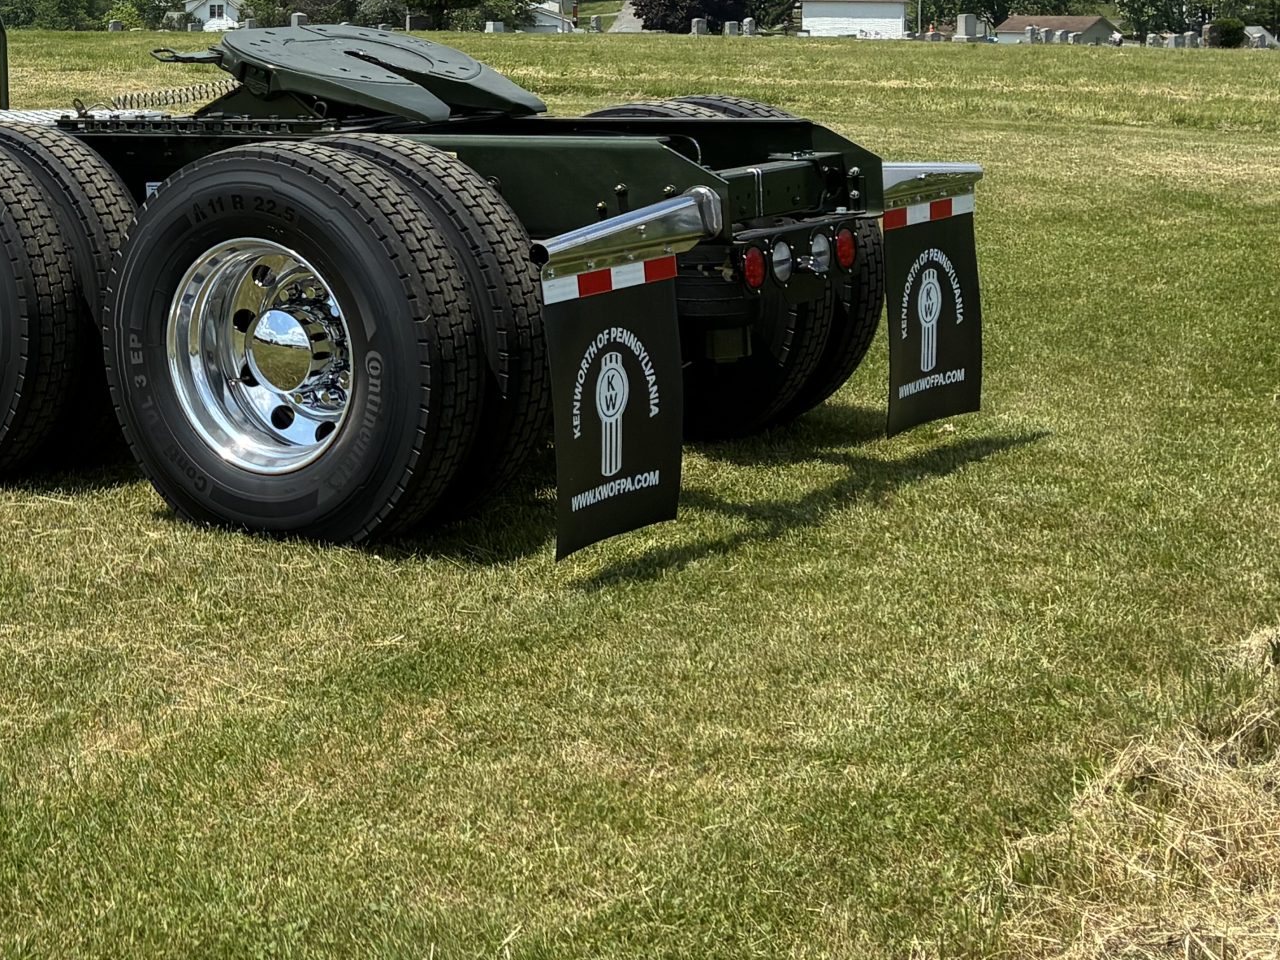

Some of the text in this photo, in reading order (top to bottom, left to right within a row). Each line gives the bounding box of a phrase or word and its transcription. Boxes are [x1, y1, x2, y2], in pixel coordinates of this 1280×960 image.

[208, 193, 297, 223] 11 R 22.5
[901, 248, 963, 339] KENWORTH OF PENNSYLVANIA
[926, 287, 933, 302] K
[924, 302, 934, 317] W
[128, 333, 144, 365] EP
[133, 374, 147, 389] 3
[573, 326, 660, 439] KENWORTH OF PENNSYLVANIA
[606, 374, 616, 392] K
[898, 367, 965, 400] WWW.KWOFPA.COM
[605, 392, 619, 412] W
[571, 469, 660, 513] WWW.KWOFPA.COM
